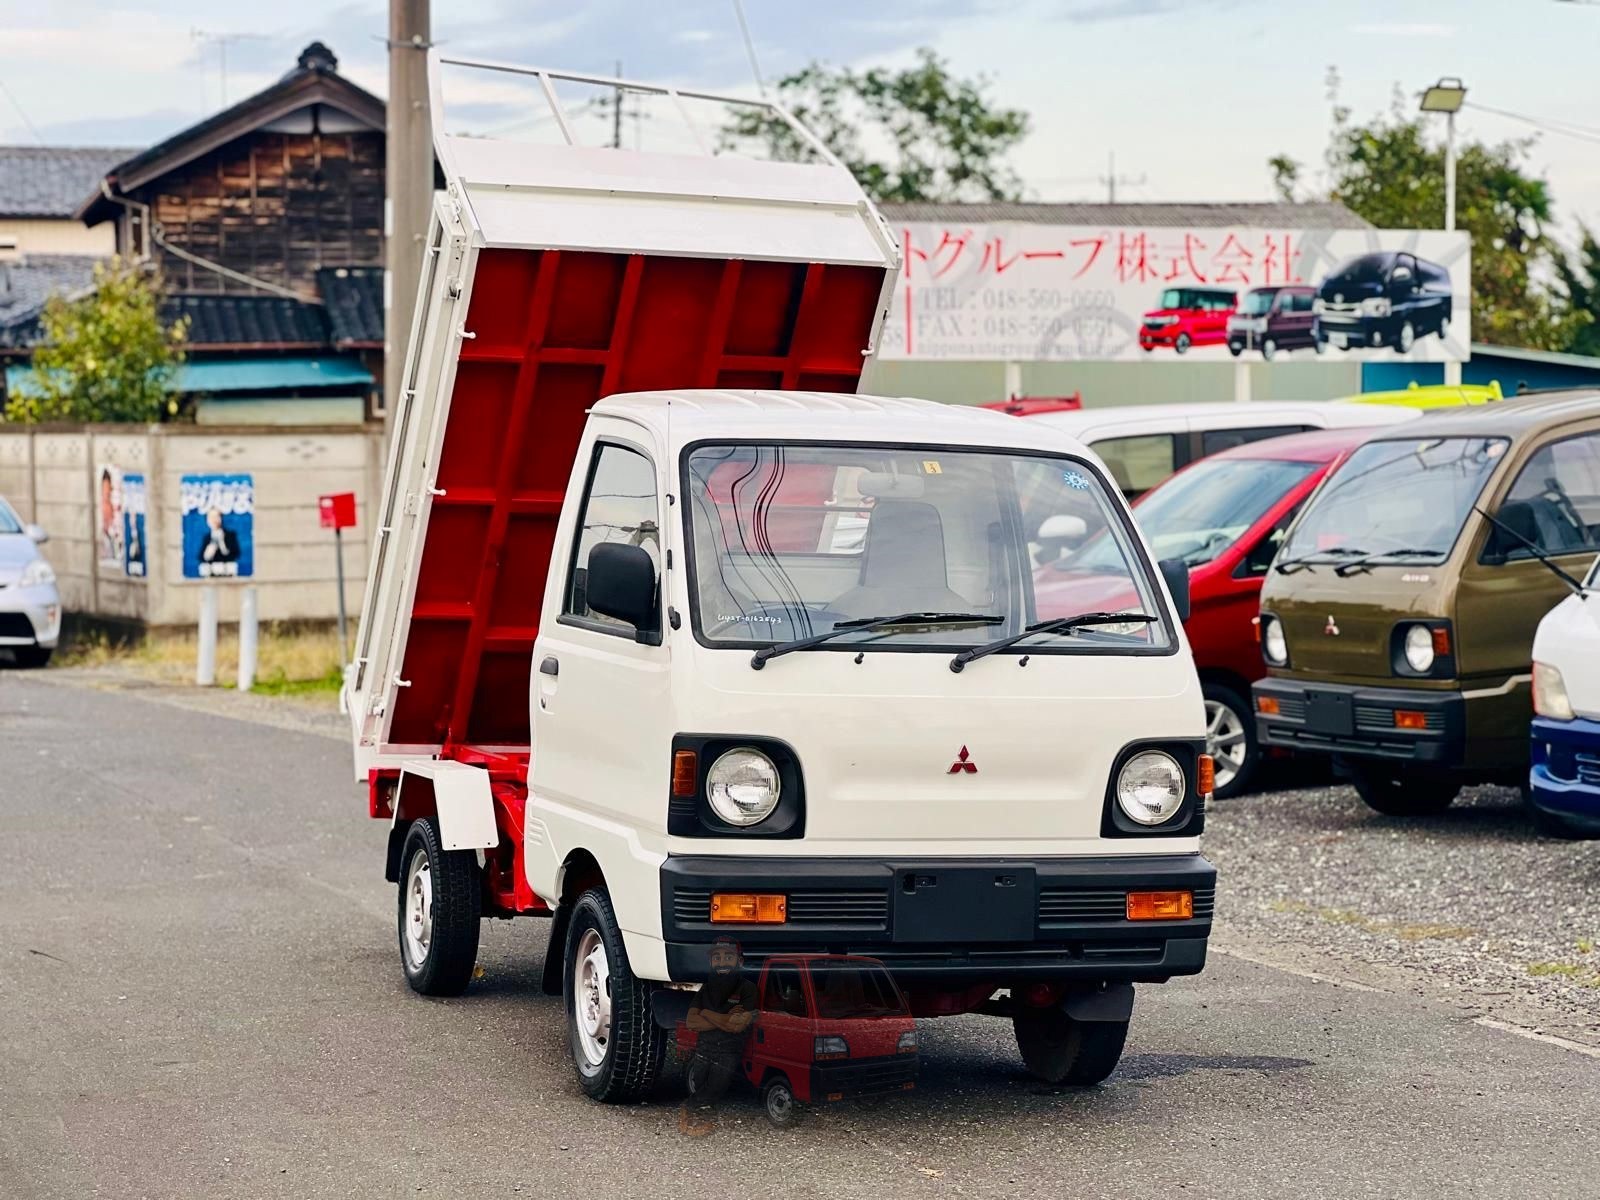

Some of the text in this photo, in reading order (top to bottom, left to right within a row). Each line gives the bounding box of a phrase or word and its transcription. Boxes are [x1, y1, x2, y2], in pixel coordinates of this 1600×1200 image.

[904, 228, 1303, 286] トグループ株式会社
